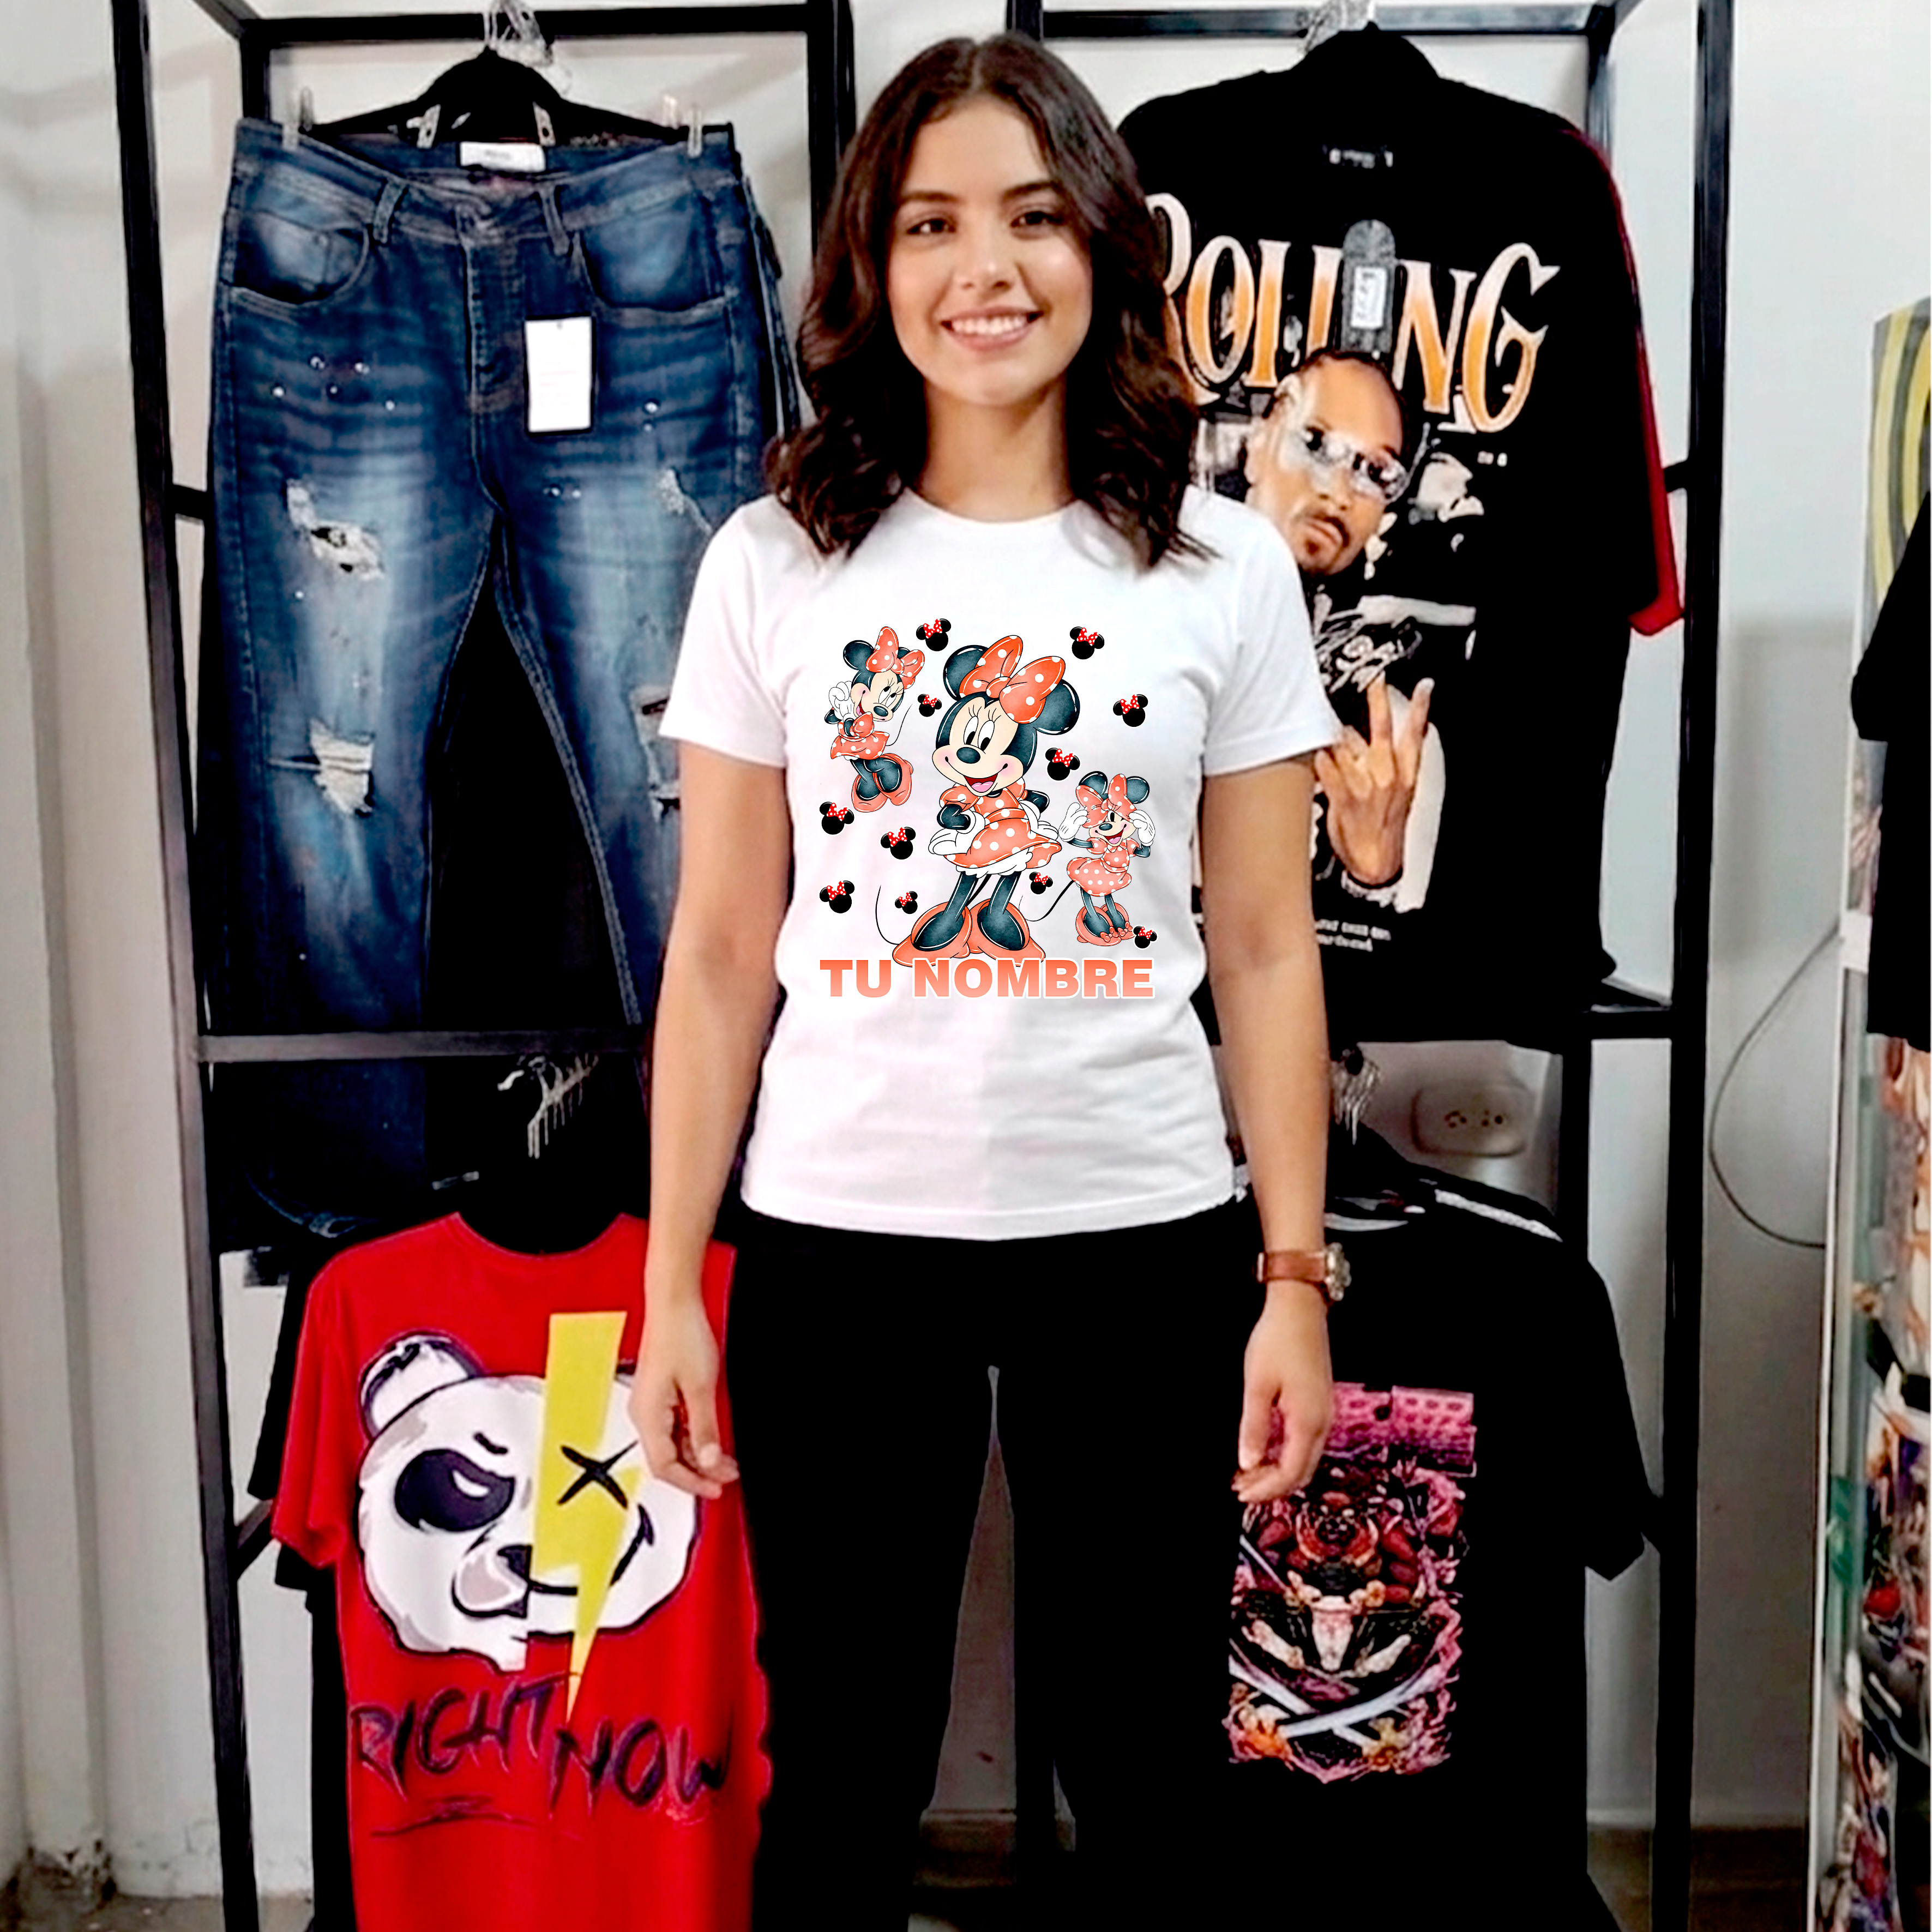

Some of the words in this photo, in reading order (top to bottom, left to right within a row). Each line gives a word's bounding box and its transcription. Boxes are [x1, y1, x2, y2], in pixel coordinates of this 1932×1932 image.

[1145, 192, 1560, 433] ROLLNG
[820, 960, 892, 997] TU
[913, 959, 1154, 998] NOMBRE
[350, 1672, 571, 1802] RIGHT
[549, 1712, 735, 1816] NOW
